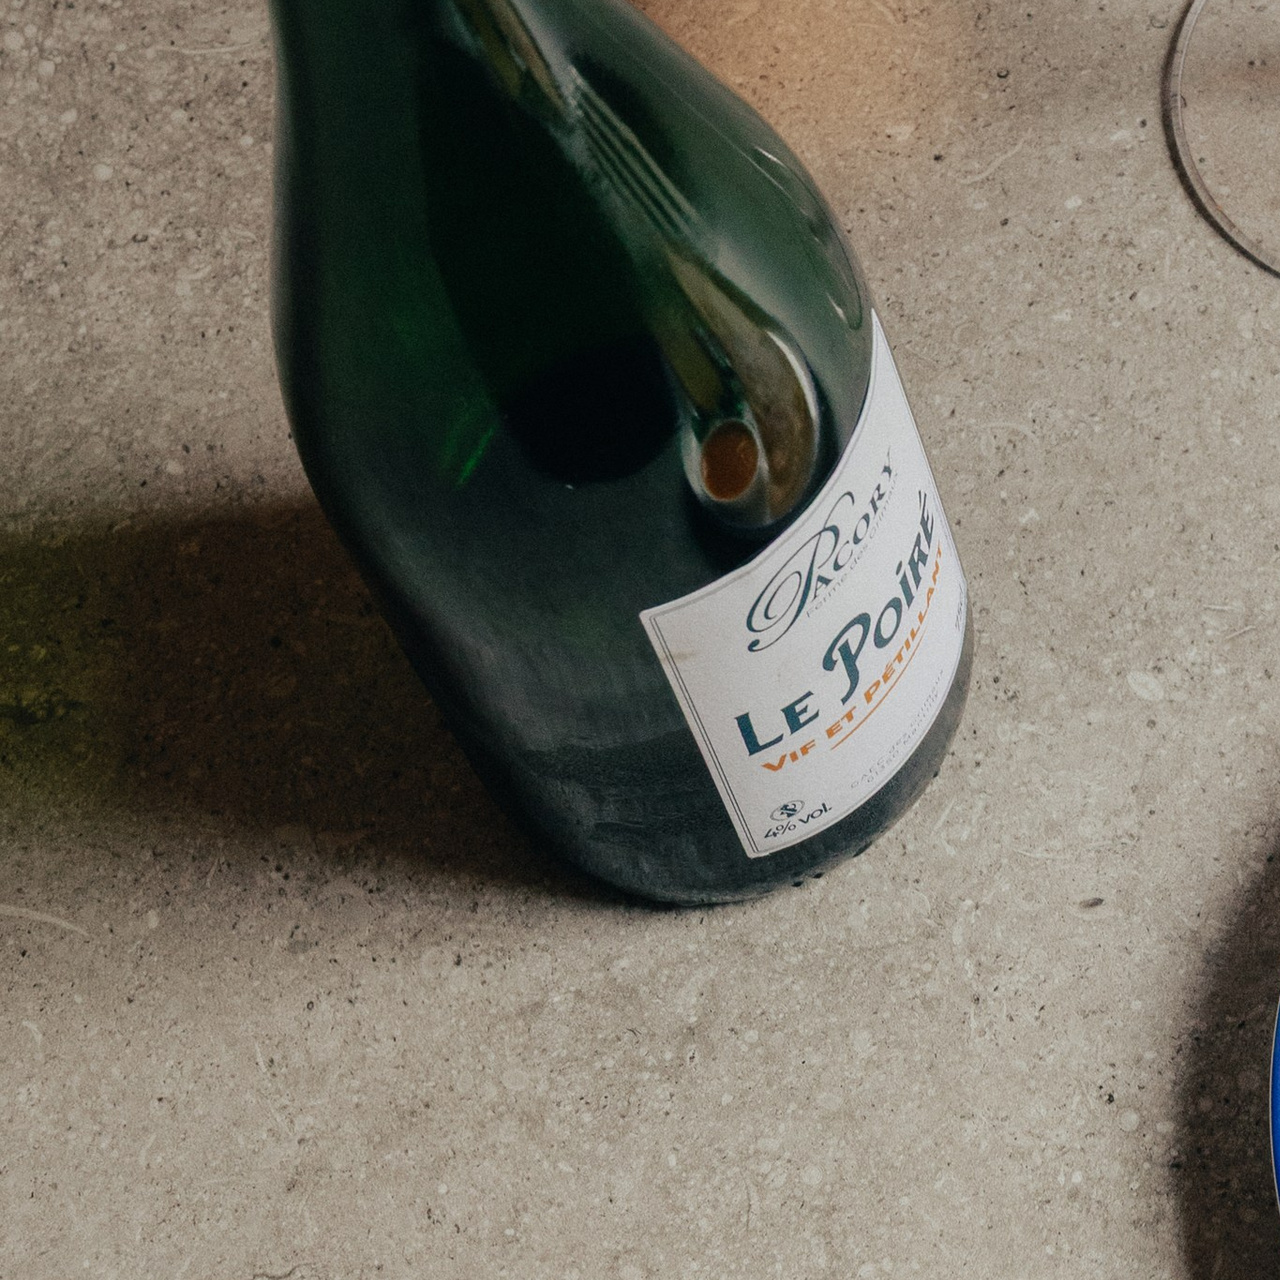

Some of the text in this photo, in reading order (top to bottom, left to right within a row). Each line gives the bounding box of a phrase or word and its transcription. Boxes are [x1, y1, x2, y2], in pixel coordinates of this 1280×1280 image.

[746, 445, 893, 653] PACORY
[734, 690, 821, 757] LE
[761, 537, 943, 773] VIF ET PÉTILLANT
[764, 820, 797, 839] 4%
